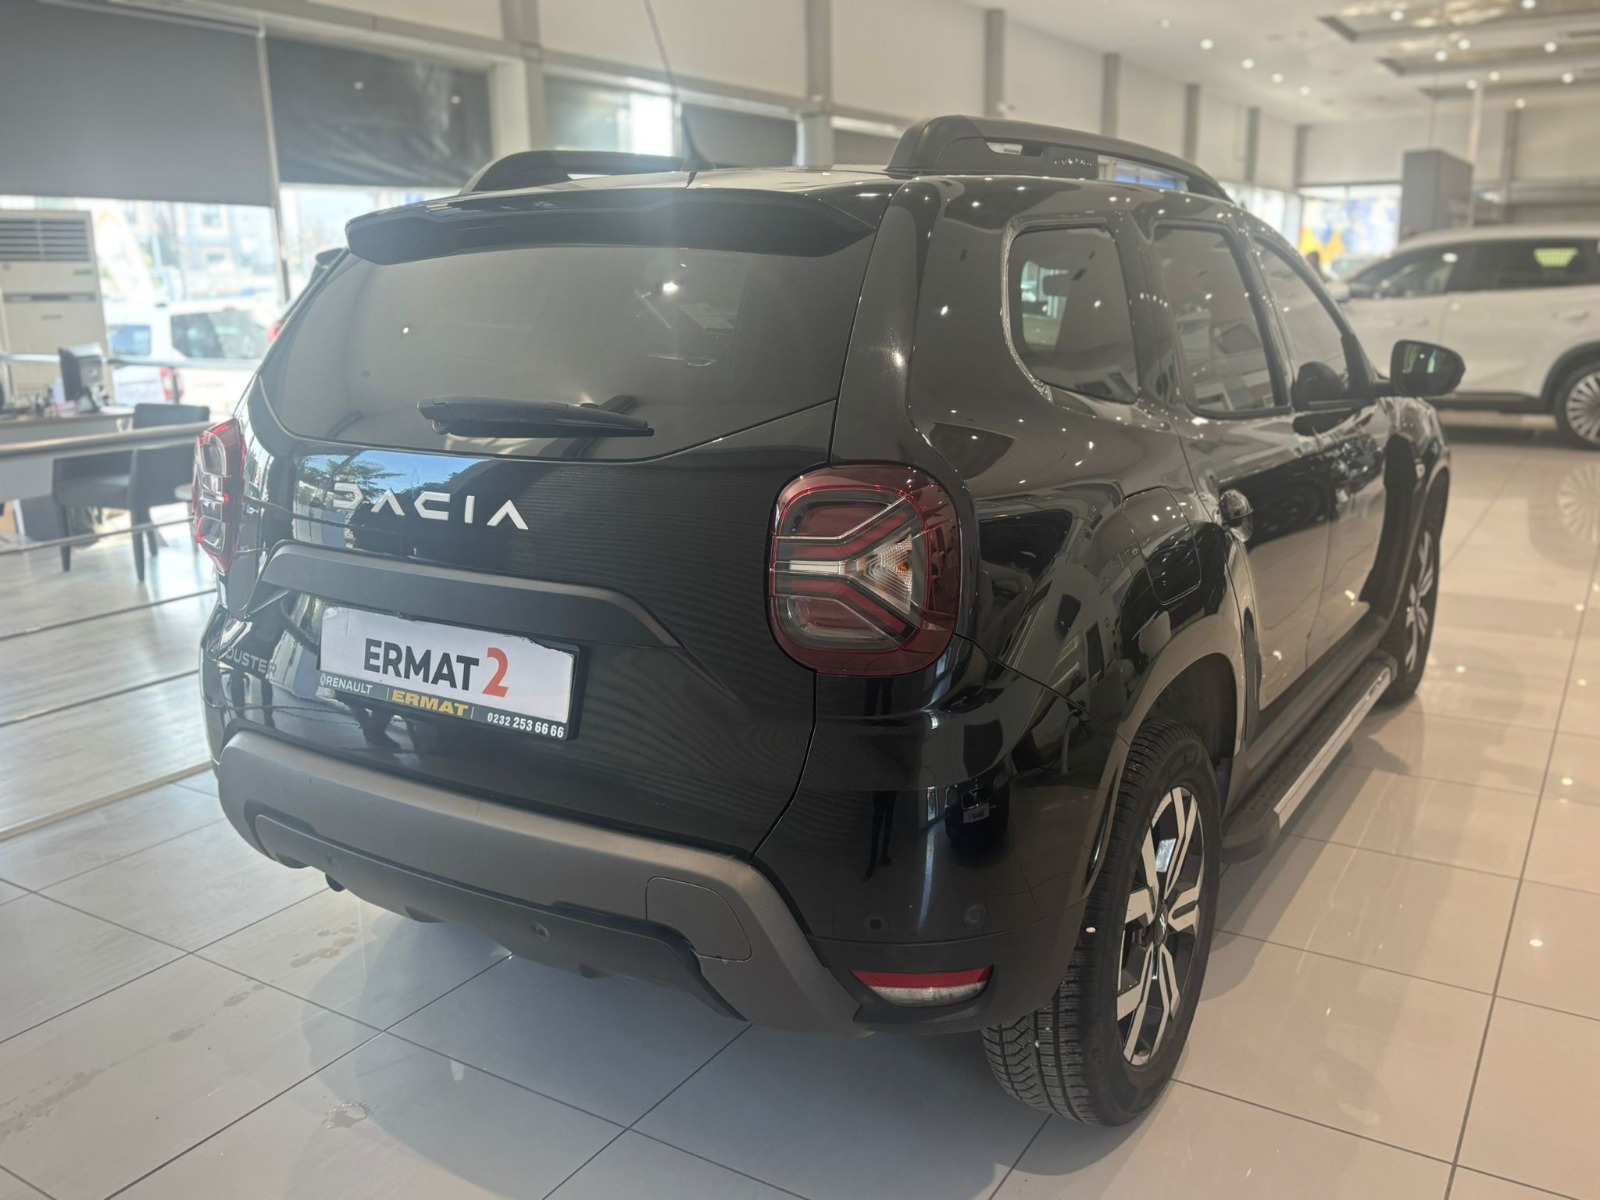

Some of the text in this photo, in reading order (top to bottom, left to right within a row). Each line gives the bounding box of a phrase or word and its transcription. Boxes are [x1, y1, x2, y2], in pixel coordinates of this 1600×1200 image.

[333, 482, 529, 530] DACIA
[225, 646, 277, 677] DUSTER
[364, 638, 509, 697] ERMAT 2
[325, 676, 373, 695] RENAULT
[392, 689, 469, 716] ERMAT
[487, 712, 564, 738] 0232 253 66 66
